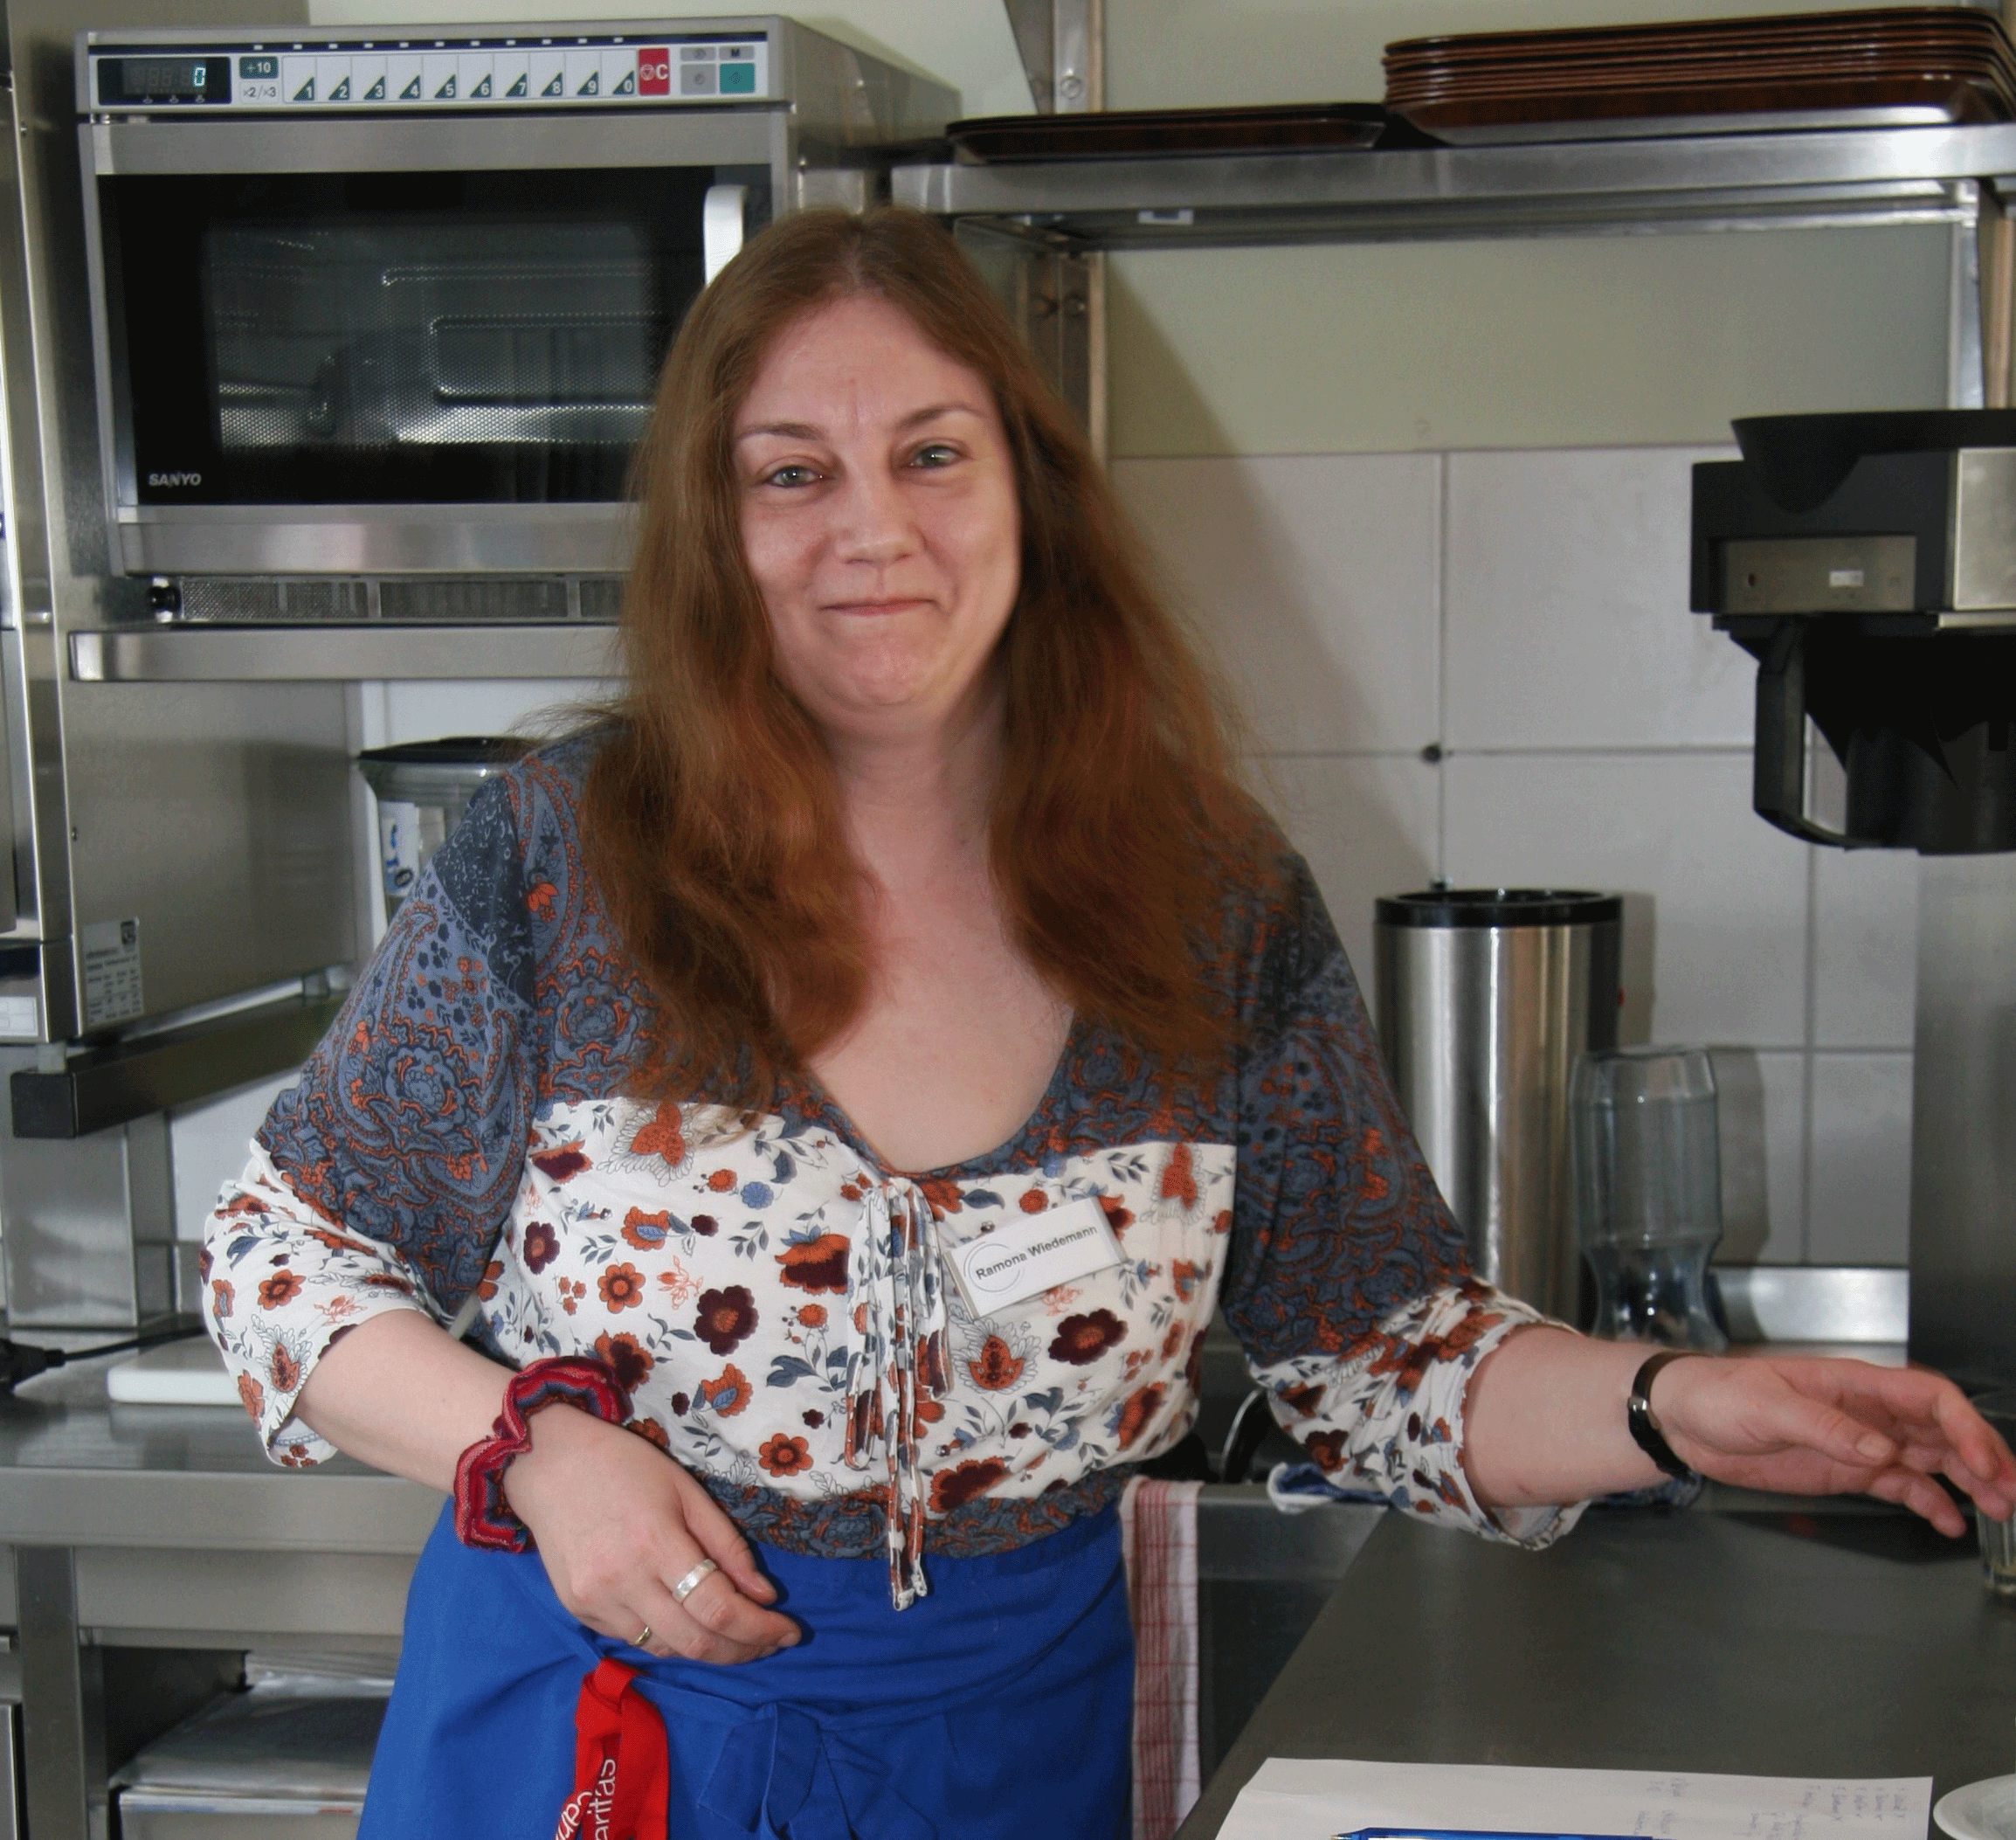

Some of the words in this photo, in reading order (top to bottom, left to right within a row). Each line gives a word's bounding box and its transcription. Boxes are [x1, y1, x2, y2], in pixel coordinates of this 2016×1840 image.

[192, 66, 206, 87] 0
[655, 63, 669, 80] C
[338, 85, 349, 98] 2
[374, 84, 383, 98] 3
[410, 84, 419, 97] 4
[445, 83, 454, 96] 5
[480, 82, 490, 95] 6
[518, 81, 526, 95] 7
[552, 80, 562, 93] 8
[588, 80, 597, 93] 9
[623, 80, 632, 93] 0
[148, 473, 202, 488] SANYO
[975, 1251, 1028, 1280] Ramona
[1027, 1225, 1098, 1258] Wiedemann
